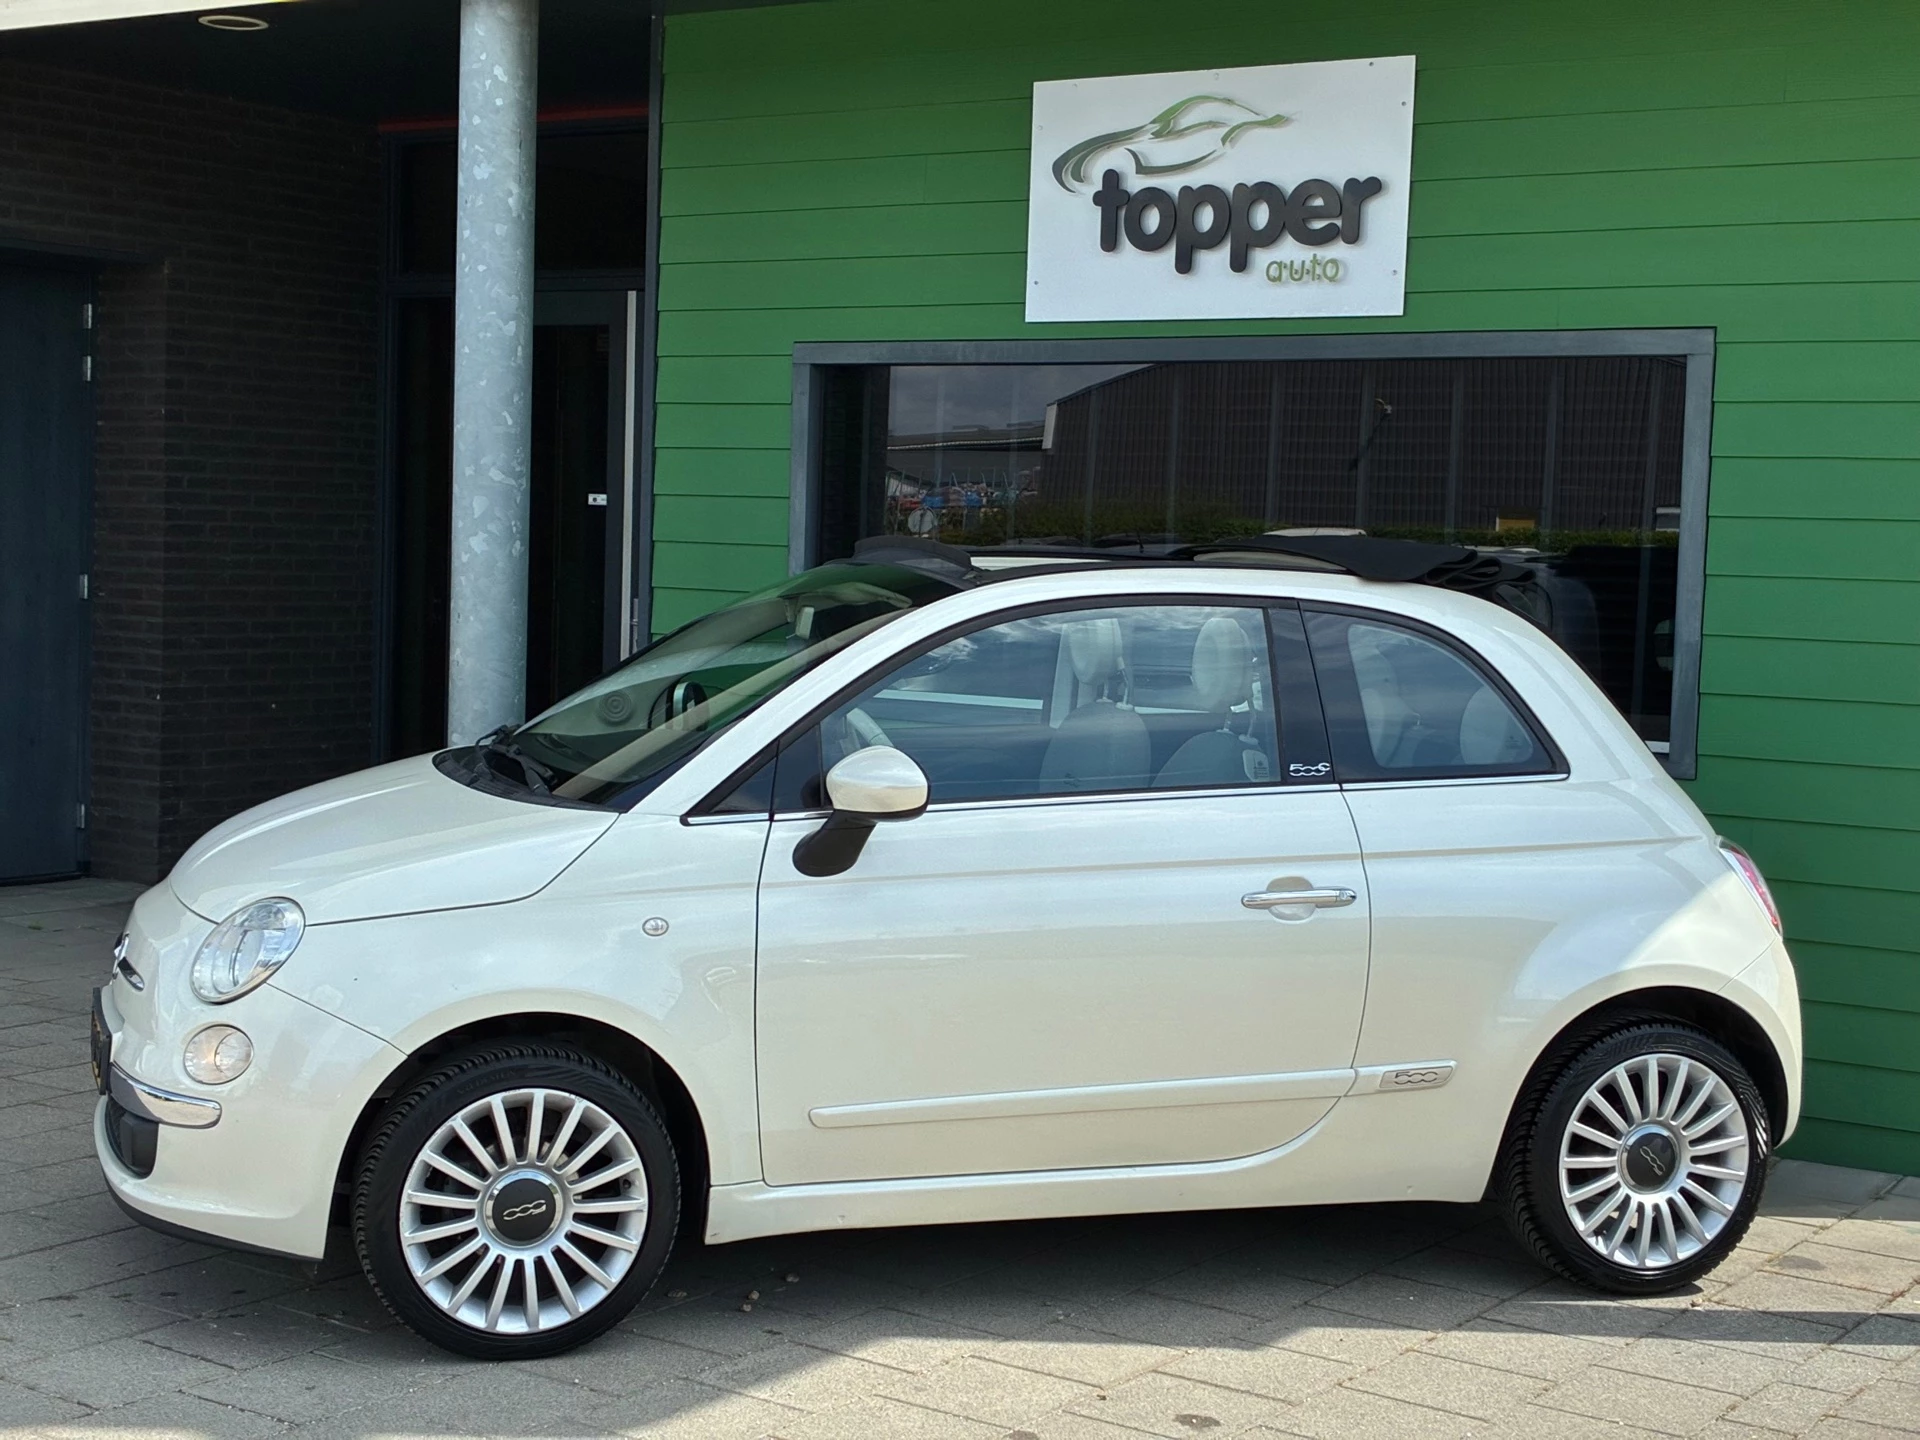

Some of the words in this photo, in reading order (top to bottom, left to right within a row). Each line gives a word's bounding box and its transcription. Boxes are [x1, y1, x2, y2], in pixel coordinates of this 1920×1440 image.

[1092, 168, 1382, 275] topper
[1265, 253, 1341, 283] auto
[1394, 1070, 1438, 1085] 500
[502, 1199, 547, 1221] 500
